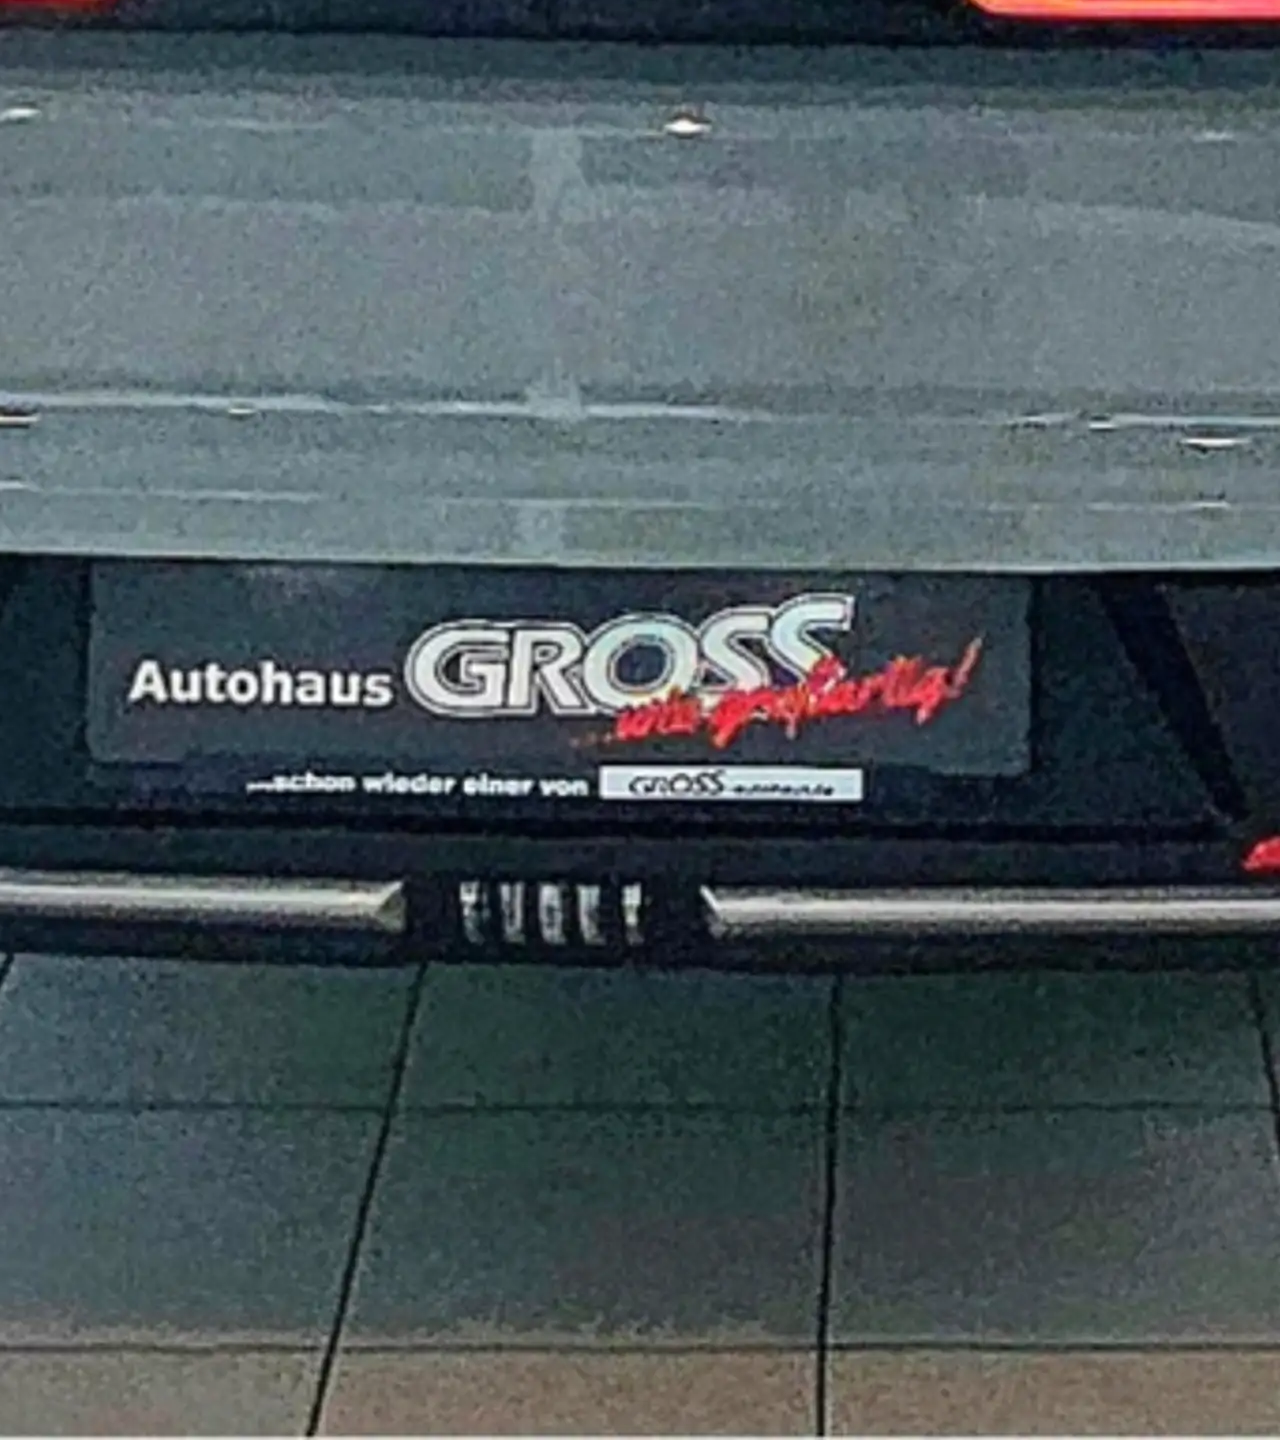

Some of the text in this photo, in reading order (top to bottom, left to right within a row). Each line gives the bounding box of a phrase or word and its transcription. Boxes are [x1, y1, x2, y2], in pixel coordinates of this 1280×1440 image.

[128, 593, 854, 718] Autohaus GROSS
[363, 773, 455, 793] wieder
[463, 773, 534, 795] einer
[540, 777, 589, 796] von
